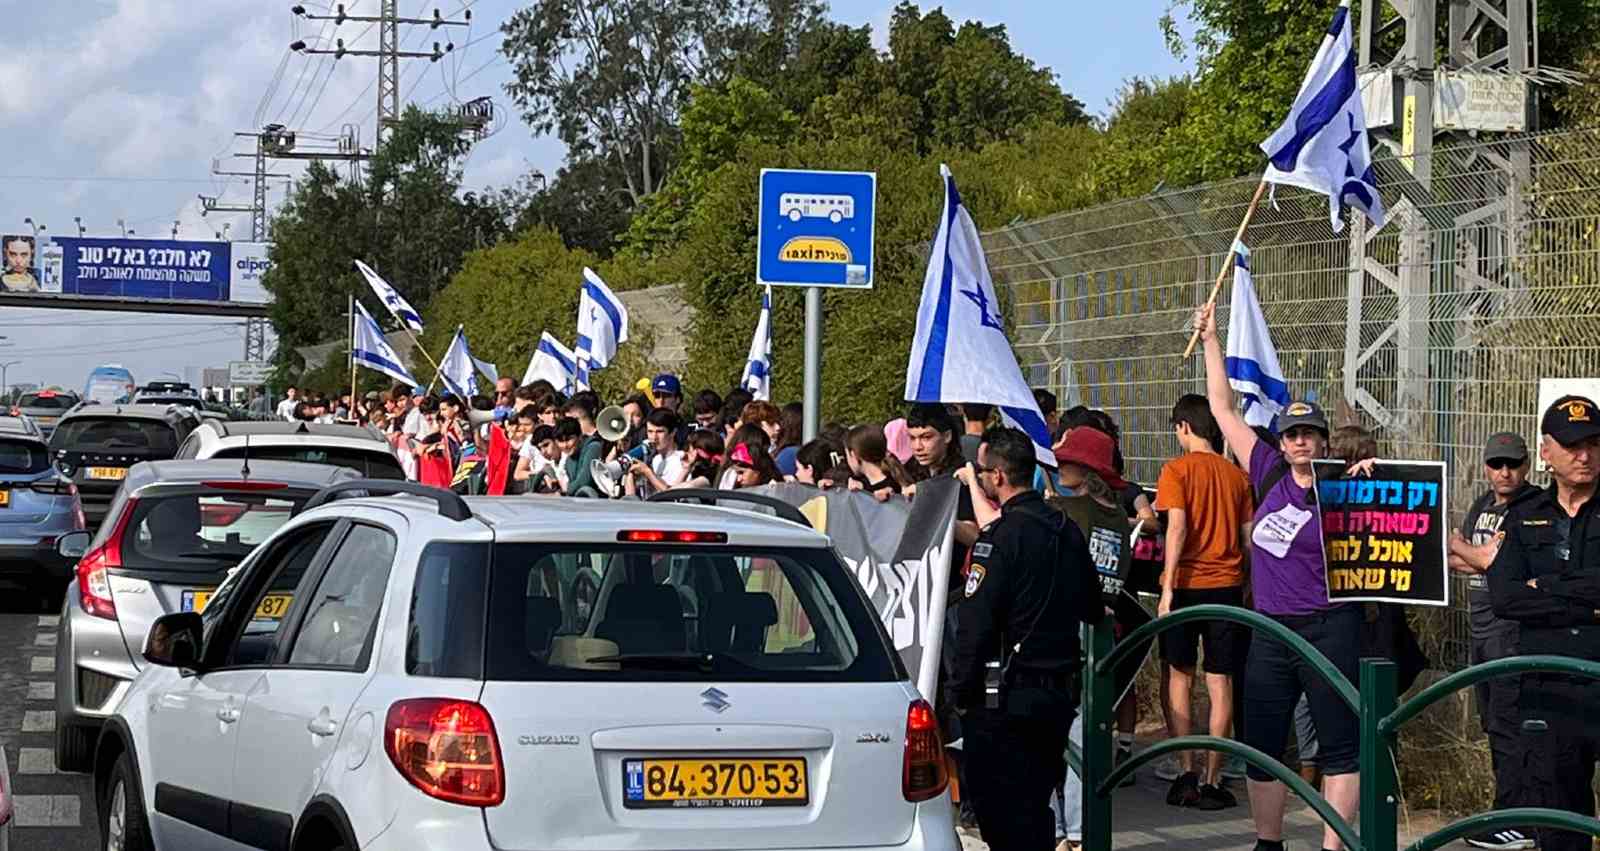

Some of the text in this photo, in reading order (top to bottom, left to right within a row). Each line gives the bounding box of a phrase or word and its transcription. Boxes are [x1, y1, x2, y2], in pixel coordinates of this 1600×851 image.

[78, 246, 104, 264] טוב
[107, 246, 123, 264] לי
[124, 247, 146, 266] בא
[149, 248, 186, 267] חלב?
[189, 249, 211, 268] לא
[77, 265, 211, 283] משקה מהצומח לאוהבי חלב
[1407, 481, 1438, 510] רק
[1368, 535, 1413, 563] אוכל
[1390, 568, 1412, 591] מי
